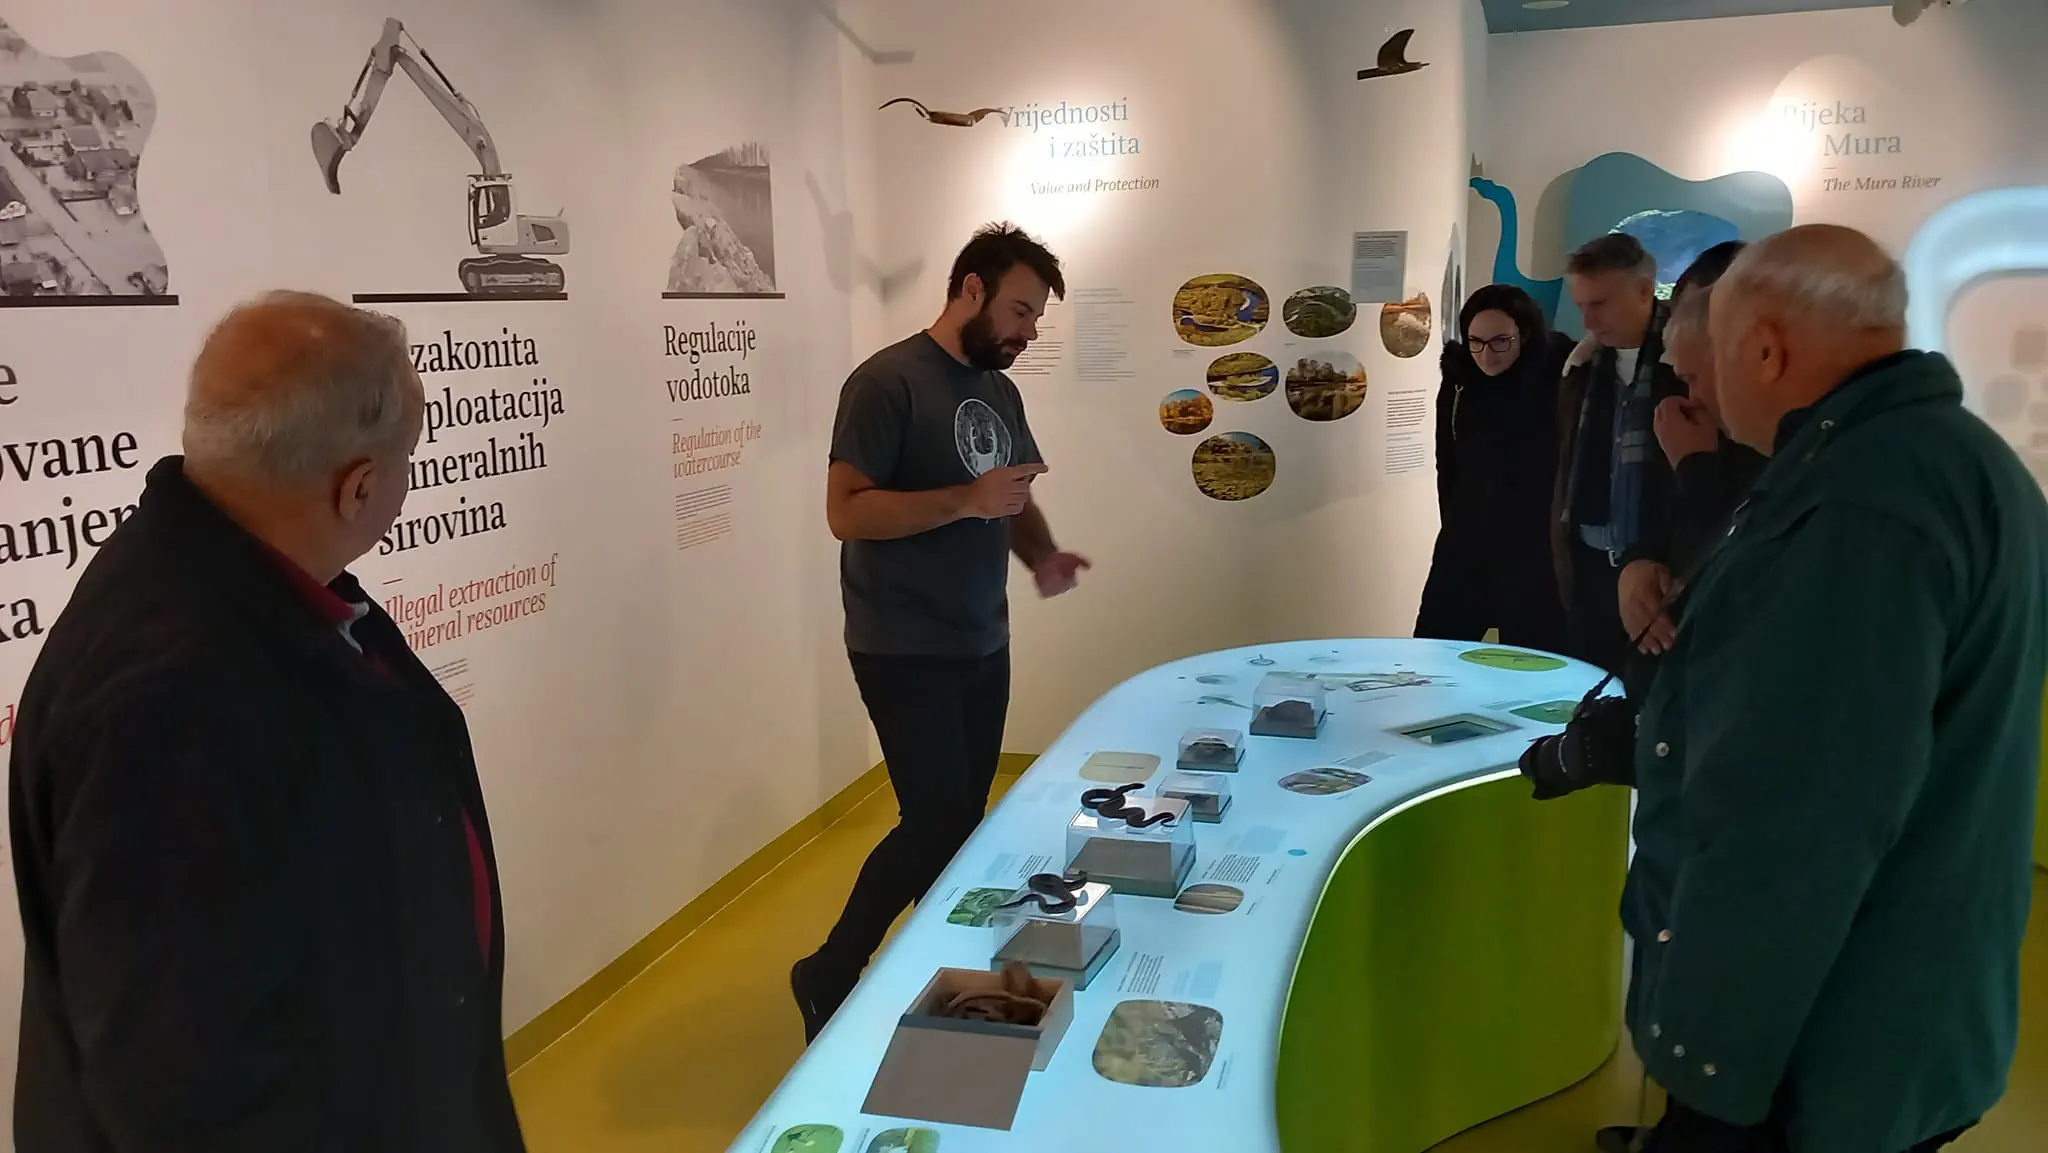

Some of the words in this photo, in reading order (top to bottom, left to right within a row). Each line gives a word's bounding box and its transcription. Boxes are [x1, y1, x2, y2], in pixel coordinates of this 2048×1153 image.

[1000, 96, 1129, 133] Vrijednosti
[1063, 132, 1141, 158] zaštita
[1823, 132, 1903, 157] Mura
[1094, 177, 1160, 192] Protection
[1824, 178, 1851, 192] The
[1855, 177, 1898, 191] Mura
[1901, 175, 1941, 190] River
[410, 326, 539, 374] zakonita
[663, 320, 757, 364] Regulacije
[666, 365, 751, 403] vodotoka
[0, 430, 139, 484] vane
[672, 425, 732, 457] Regulation
[734, 419, 746, 449] of
[746, 422, 762, 440] the
[409, 431, 548, 491] ineralnih
[673, 450, 742, 479] watercourse
[385, 583, 444, 628] Illegal
[448, 564, 537, 609] extraction
[540, 552, 559, 588] of
[408, 609, 463, 651] ineral
[467, 592, 547, 634] resources
